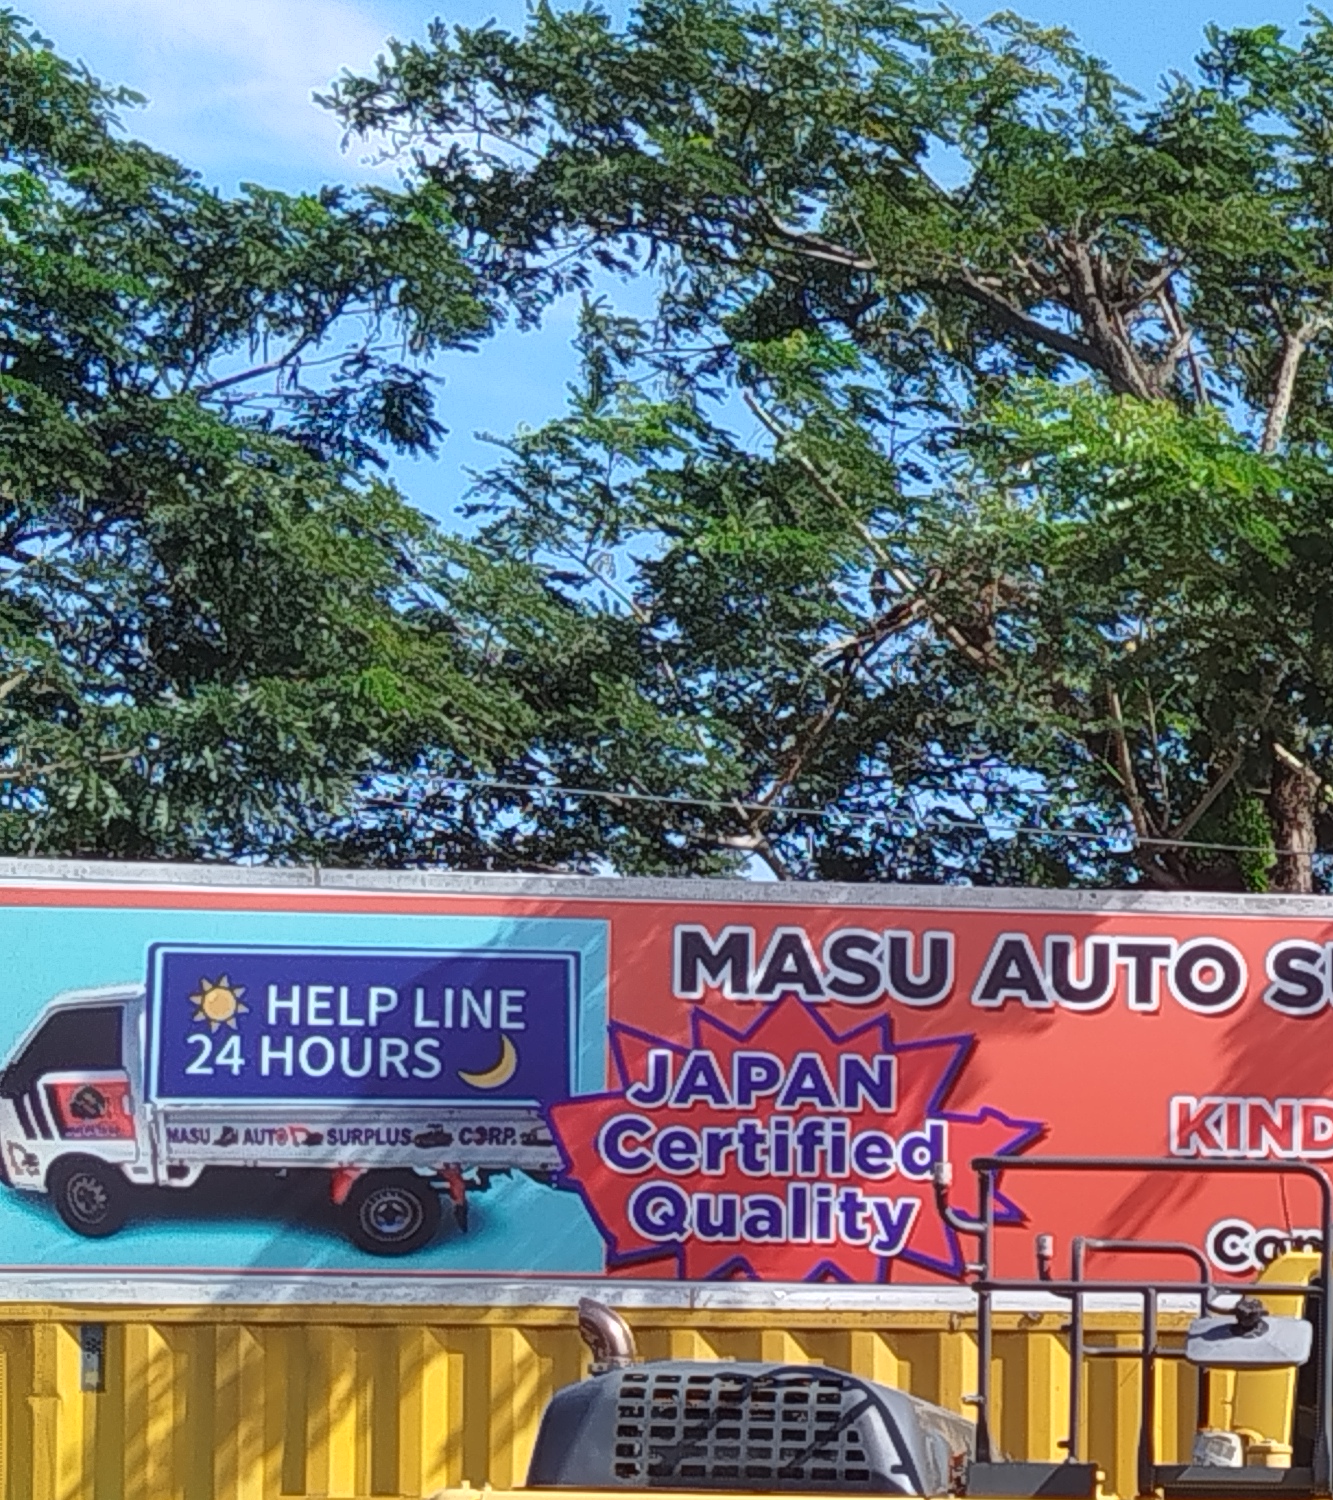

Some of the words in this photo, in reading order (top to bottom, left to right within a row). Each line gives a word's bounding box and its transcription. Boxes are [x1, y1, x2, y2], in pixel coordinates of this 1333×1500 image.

[677, 927, 951, 1003] MASU
[976, 934, 1245, 1011] AUTO
[267, 984, 398, 1028] HELP
[413, 987, 527, 1031] LINE
[186, 1033, 245, 1076] 24
[260, 1035, 442, 1079] HOURS
[629, 1050, 896, 1111] JAPAN
[167, 1126, 211, 1145] MASU
[243, 1126, 288, 1147] AUTO
[326, 1127, 414, 1147] SURPLUS
[602, 1116, 946, 1177] Certified
[632, 1181, 917, 1254] Quality
